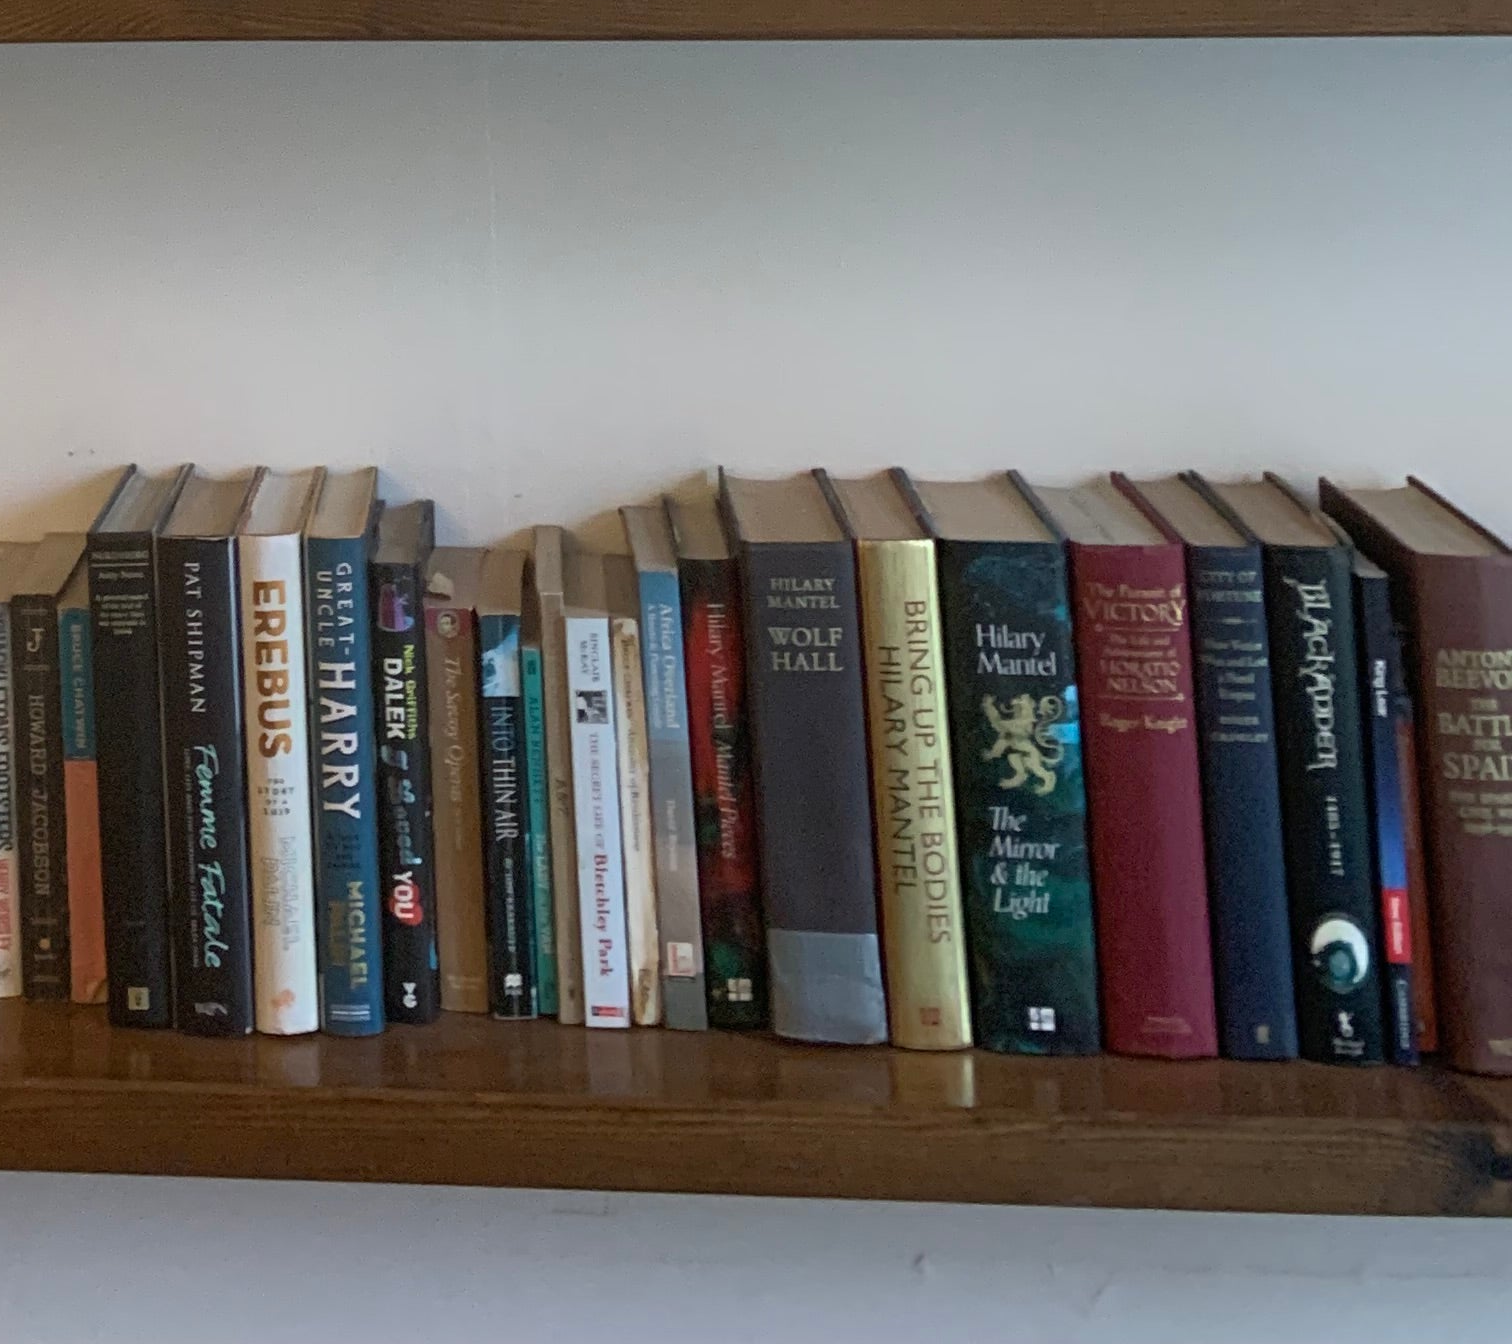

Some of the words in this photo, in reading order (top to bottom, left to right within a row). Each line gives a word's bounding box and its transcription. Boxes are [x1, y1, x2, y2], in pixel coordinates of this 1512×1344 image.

[183, 561, 202, 603] PAT
[766, 594, 841, 610] MANTEL
[770, 576, 835, 593] HILARY
[316, 570, 335, 648] UNCLE
[334, 562, 355, 657] GREAT-
[658, 603, 676, 652] Africa
[705, 603, 727, 657] Hilary
[1083, 598, 1187, 627] VICTORY
[71, 623, 84, 672] BRUCE
[185, 607, 207, 713] SHIPMAN
[403, 644, 416, 675] Nick
[589, 632, 600, 683] SINCLAIR
[767, 626, 843, 649] WOLF
[770, 651, 844, 672] HALL
[904, 600, 932, 695] BRING
[976, 624, 1046, 659] Hilary
[252, 579, 292, 759] EREBUS
[443, 656, 461, 689] The
[977, 650, 1058, 677] Mantel
[1284, 575, 1339, 770] BLACKADDER
[1372, 659, 1387, 688] King
[1435, 668, 1512, 689] BEEVO
[72, 676, 87, 749] CHATWIN
[382, 657, 406, 739] DALEK
[404, 679, 419, 740] Griffiths
[442, 692, 463, 741] Savoy
[528, 696, 541, 737] ALAN
[662, 655, 680, 729] Overland
[709, 664, 731, 732] Mantel
[879, 645, 907, 761] HILARY
[1375, 690, 1390, 717] Lear
[28, 694, 46, 776] HOWARD
[318, 660, 361, 820] HARRY
[490, 705, 516, 752] INTO
[589, 732, 600, 756] THE
[910, 708, 935, 749] UP
[1438, 713, 1512, 737] BATTL
[444, 744, 466, 802] Operas
[492, 756, 517, 804] THIN
[530, 742, 545, 805] BENNETT
[590, 759, 602, 802] SECRET
[714, 739, 735, 803] Mantel
[1442, 752, 1512, 780] SPAI
[193, 744, 222, 850] Femme
[914, 757, 941, 827] THE
[30, 787, 51, 896] JACOBSON
[494, 807, 519, 842] AIR
[593, 833, 605, 849] OF
[719, 808, 740, 860] Pieces
[886, 771, 918, 896] MANTEL
[989, 806, 1028, 834] The
[989, 834, 1060, 861] Mirror
[392, 870, 414, 920] YOU
[592, 853, 611, 932] Bletchley
[920, 831, 953, 945] BODIES
[990, 862, 1009, 886] &
[1015, 862, 1049, 887] the
[197, 860, 231, 968] Fatale
[994, 890, 1050, 921] Light
[347, 880, 367, 990] MICHAEL
[596, 938, 613, 978] Park
